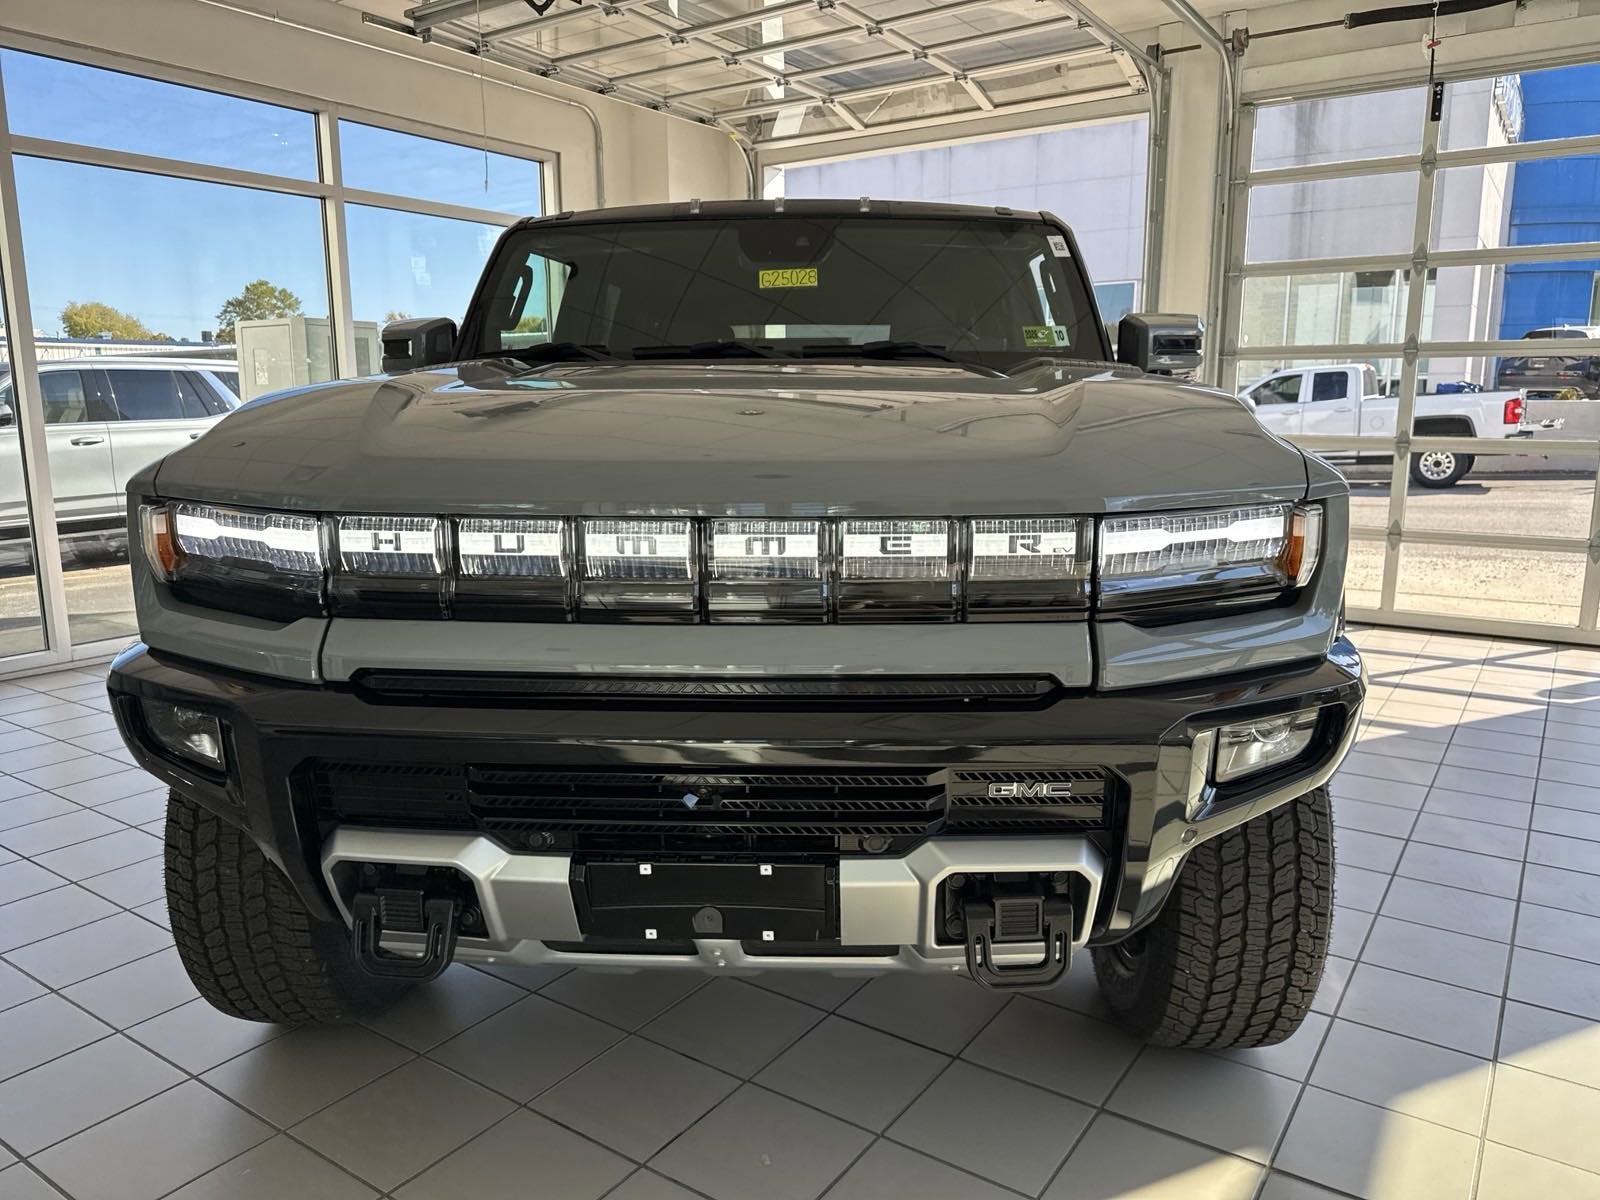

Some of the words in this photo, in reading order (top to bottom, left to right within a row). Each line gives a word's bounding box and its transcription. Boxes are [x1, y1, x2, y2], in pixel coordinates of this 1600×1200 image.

[761, 269, 817, 288] G25028
[1054, 329, 1065, 341] 10
[371, 532, 1041, 555] HUMMER
[989, 782, 1071, 797] GMC
